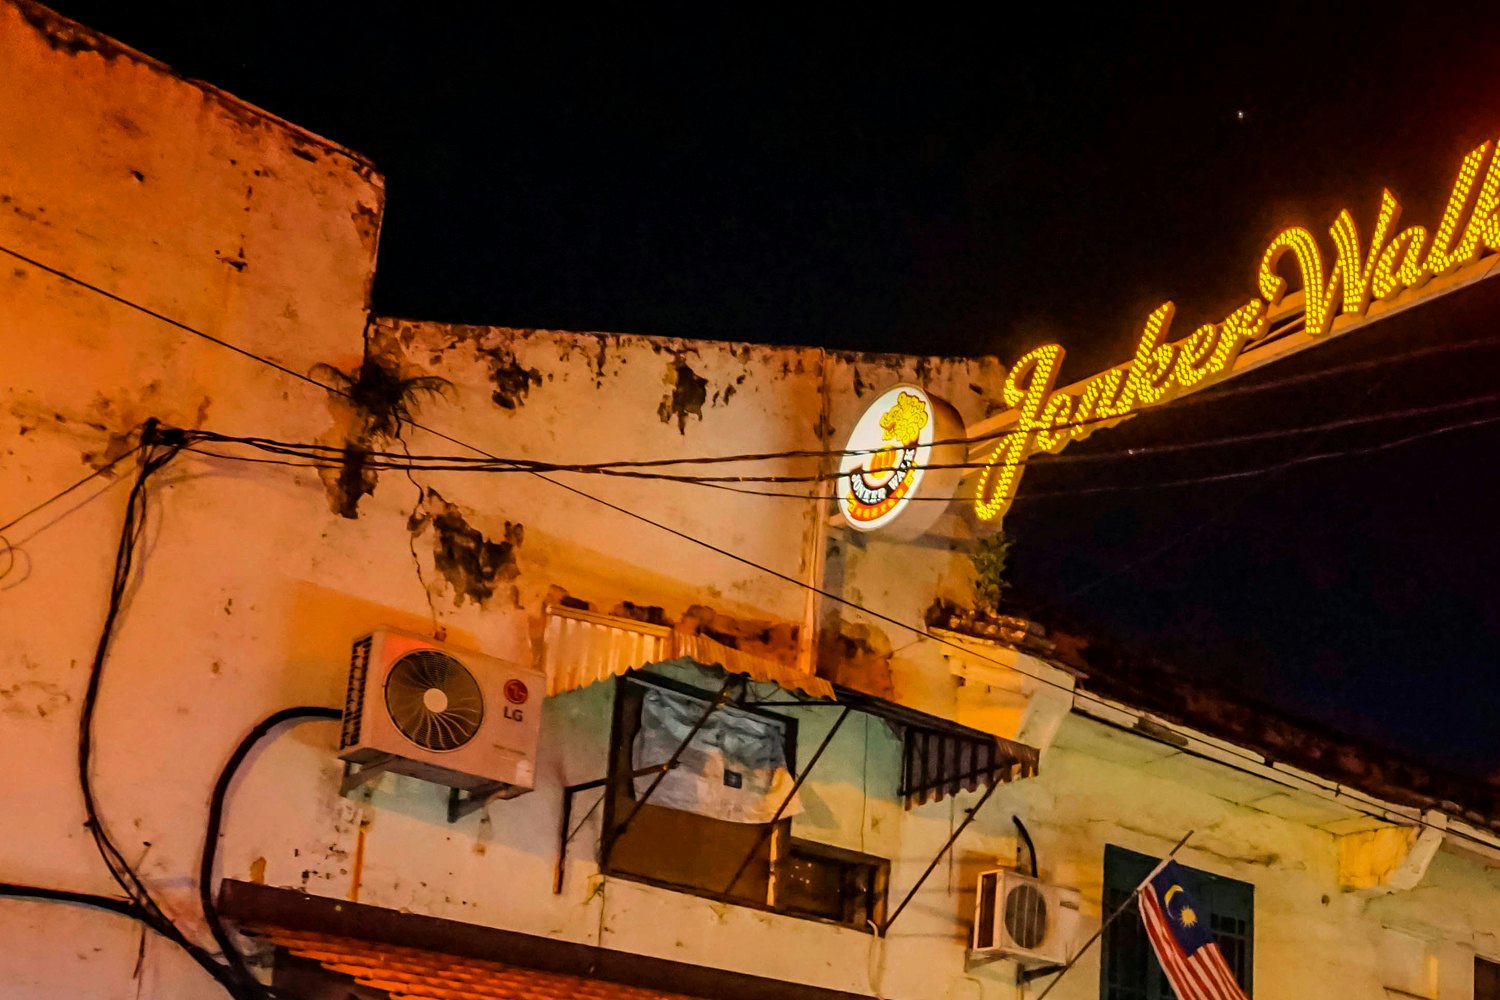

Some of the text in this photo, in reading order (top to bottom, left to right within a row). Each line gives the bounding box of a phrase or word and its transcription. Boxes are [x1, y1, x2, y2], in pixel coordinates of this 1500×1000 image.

[974, 299, 1268, 521] Jonker
[851, 448, 916, 504] JONKER WALK
[503, 705, 523, 722] LG
